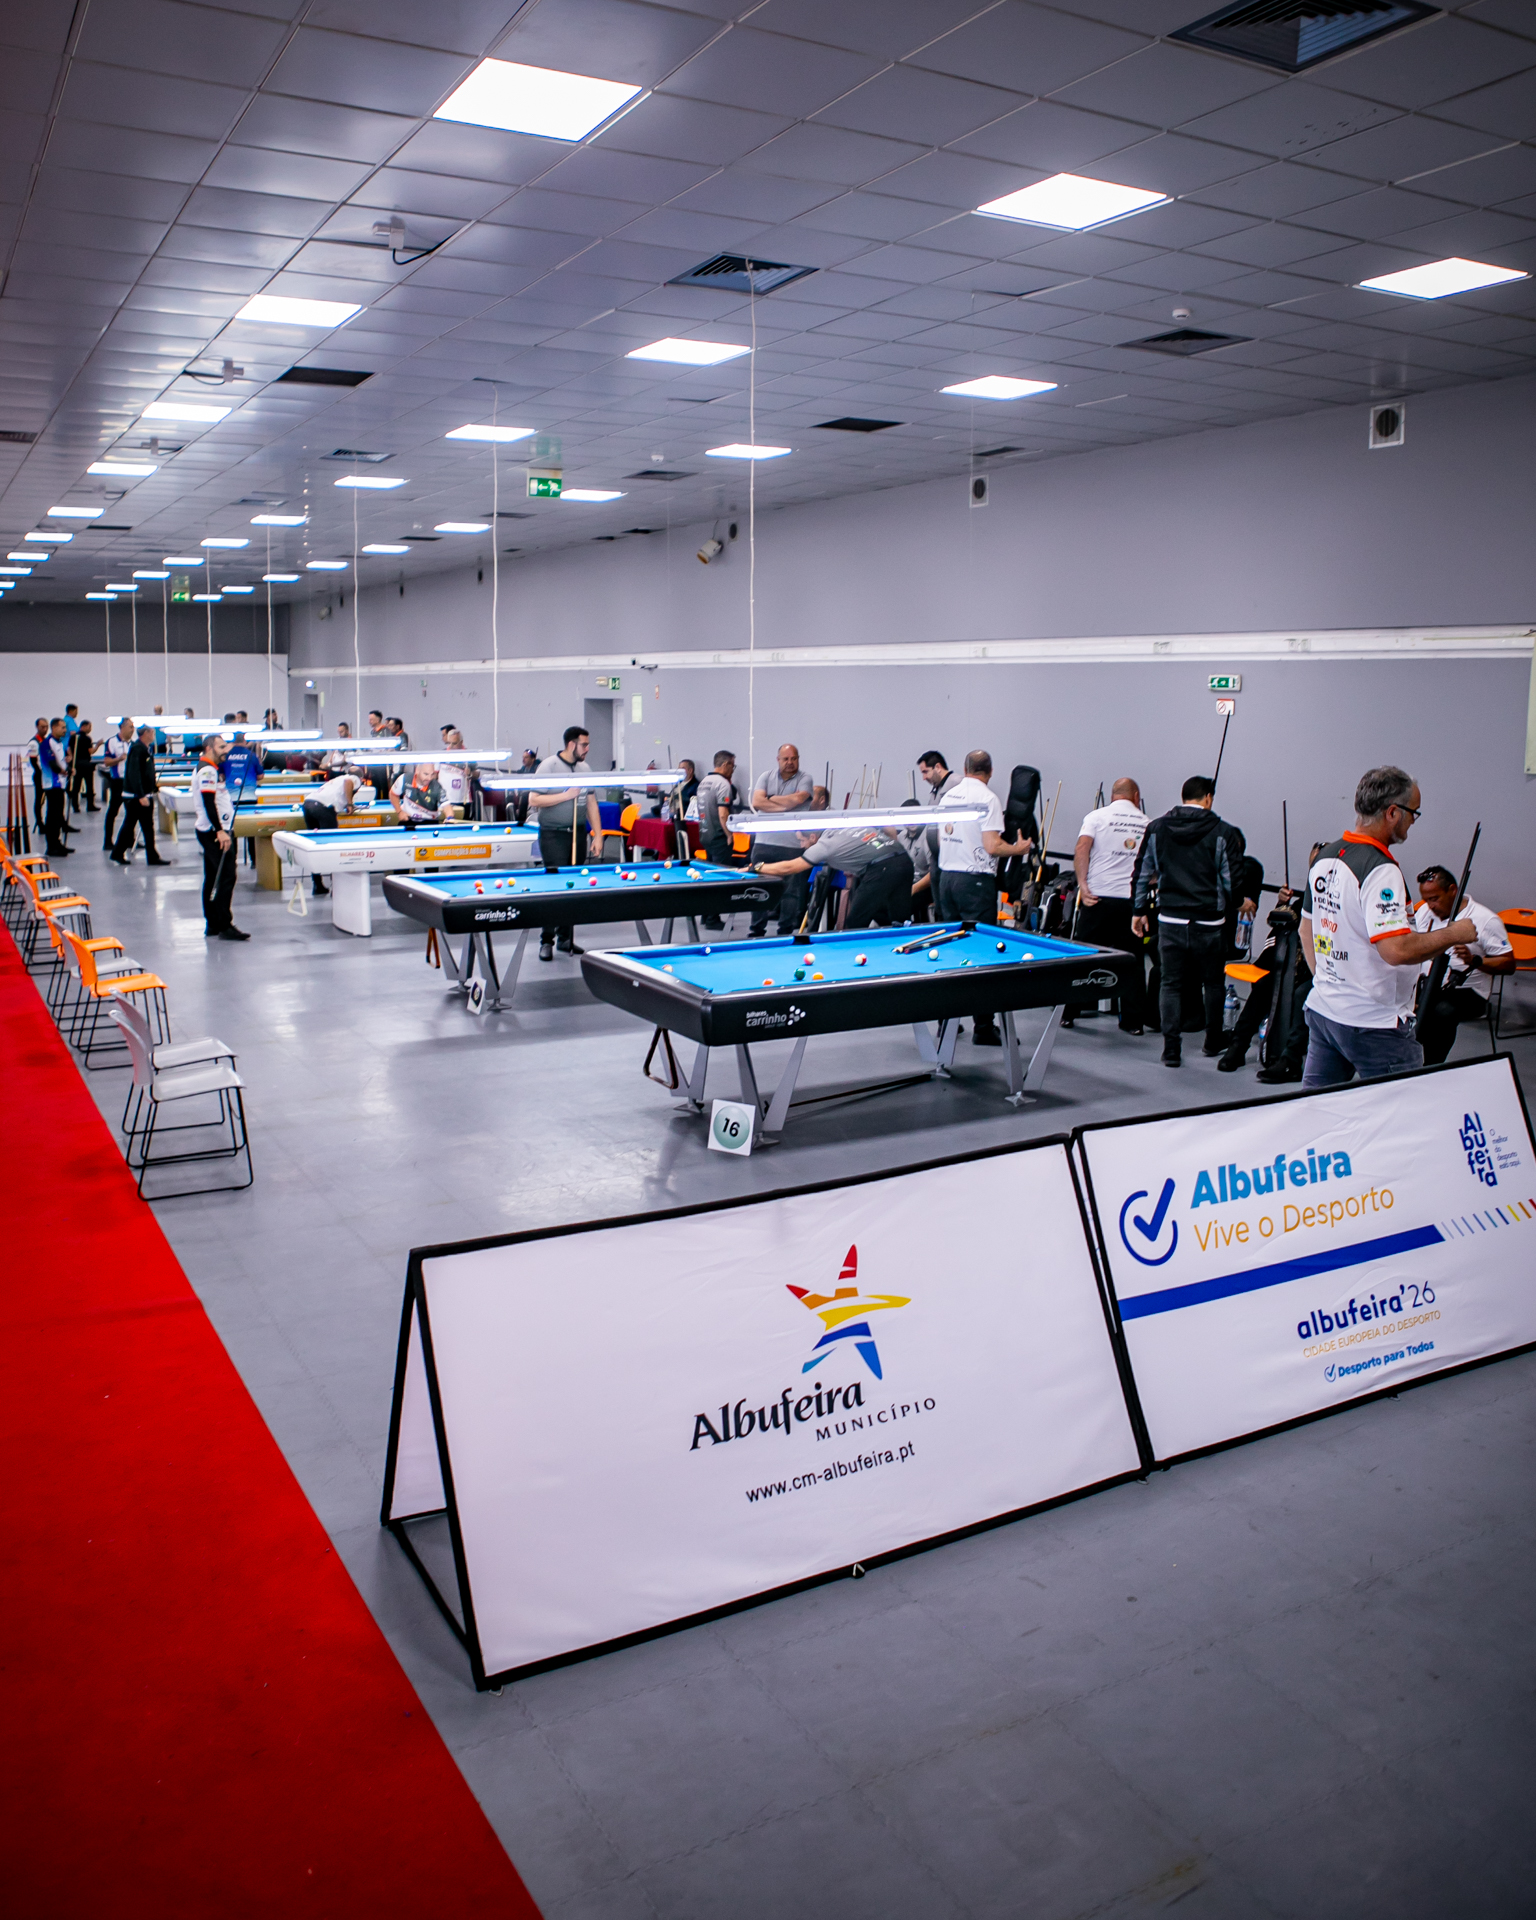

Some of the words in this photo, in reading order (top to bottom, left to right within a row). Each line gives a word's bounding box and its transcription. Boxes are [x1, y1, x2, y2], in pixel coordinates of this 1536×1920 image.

[474, 910, 506, 920] carrinho
[746, 1012, 787, 1027] carrinho
[722, 1117, 740, 1137] 16
[1190, 1148, 1352, 1209] Albufeira
[1194, 1219, 1249, 1252] Vive
[1258, 1216, 1274, 1238] o
[1283, 1186, 1394, 1233] Desporto
[1303, 1340, 1337, 1358] CIDADE
[1338, 1327, 1380, 1349] EUROPEIA
[1382, 1323, 1396, 1336] DO
[1397, 1310, 1441, 1331] DESPORTO
[1338, 1356, 1381, 1377] Desporto
[1383, 1350, 1405, 1365] para
[1406, 1341, 1435, 1356] Todos
[690, 1381, 865, 1450] Albufeira
[816, 1397, 936, 1441] MUNICÍPIO
[746, 1441, 915, 1502] www.cm-albufeira.pt
